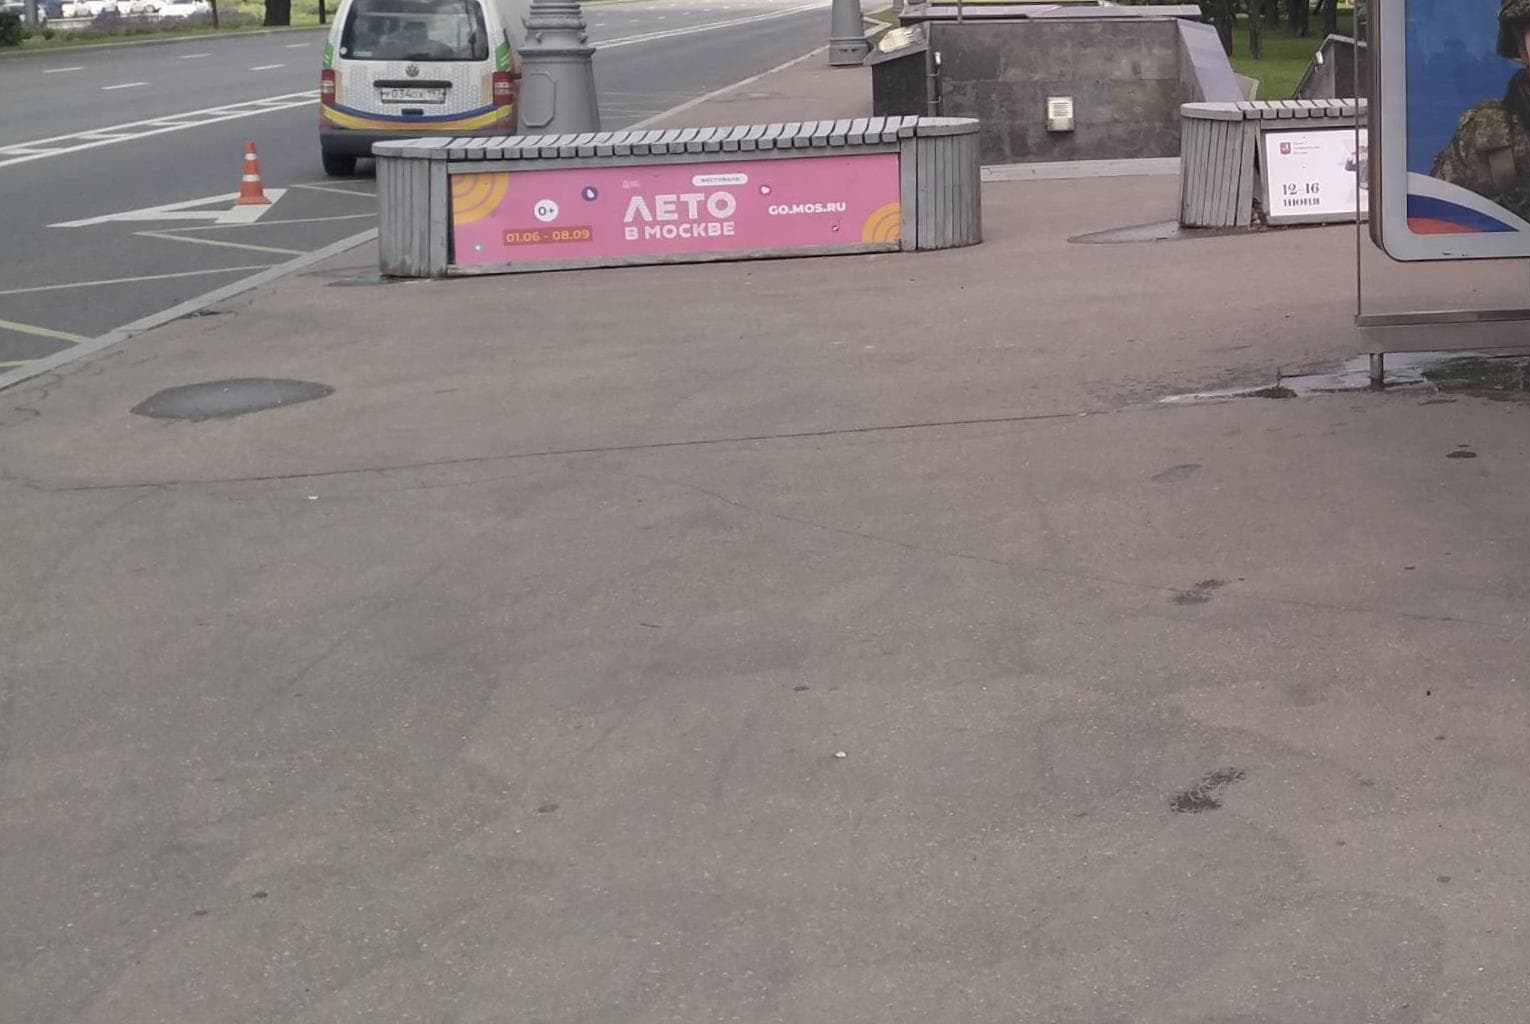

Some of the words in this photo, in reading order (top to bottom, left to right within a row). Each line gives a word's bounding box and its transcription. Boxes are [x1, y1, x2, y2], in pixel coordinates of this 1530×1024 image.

[623, 191, 737, 223] ЛЕТО
[768, 202, 846, 215] GO.MOS.RU
[1283, 198, 1320, 207] июня
[538, 206, 555, 217] 0+
[506, 231, 541, 243] 01.06
[552, 229, 590, 241] 08.09
[624, 226, 639, 240] В
[644, 221, 736, 240] МОСКВЕ
